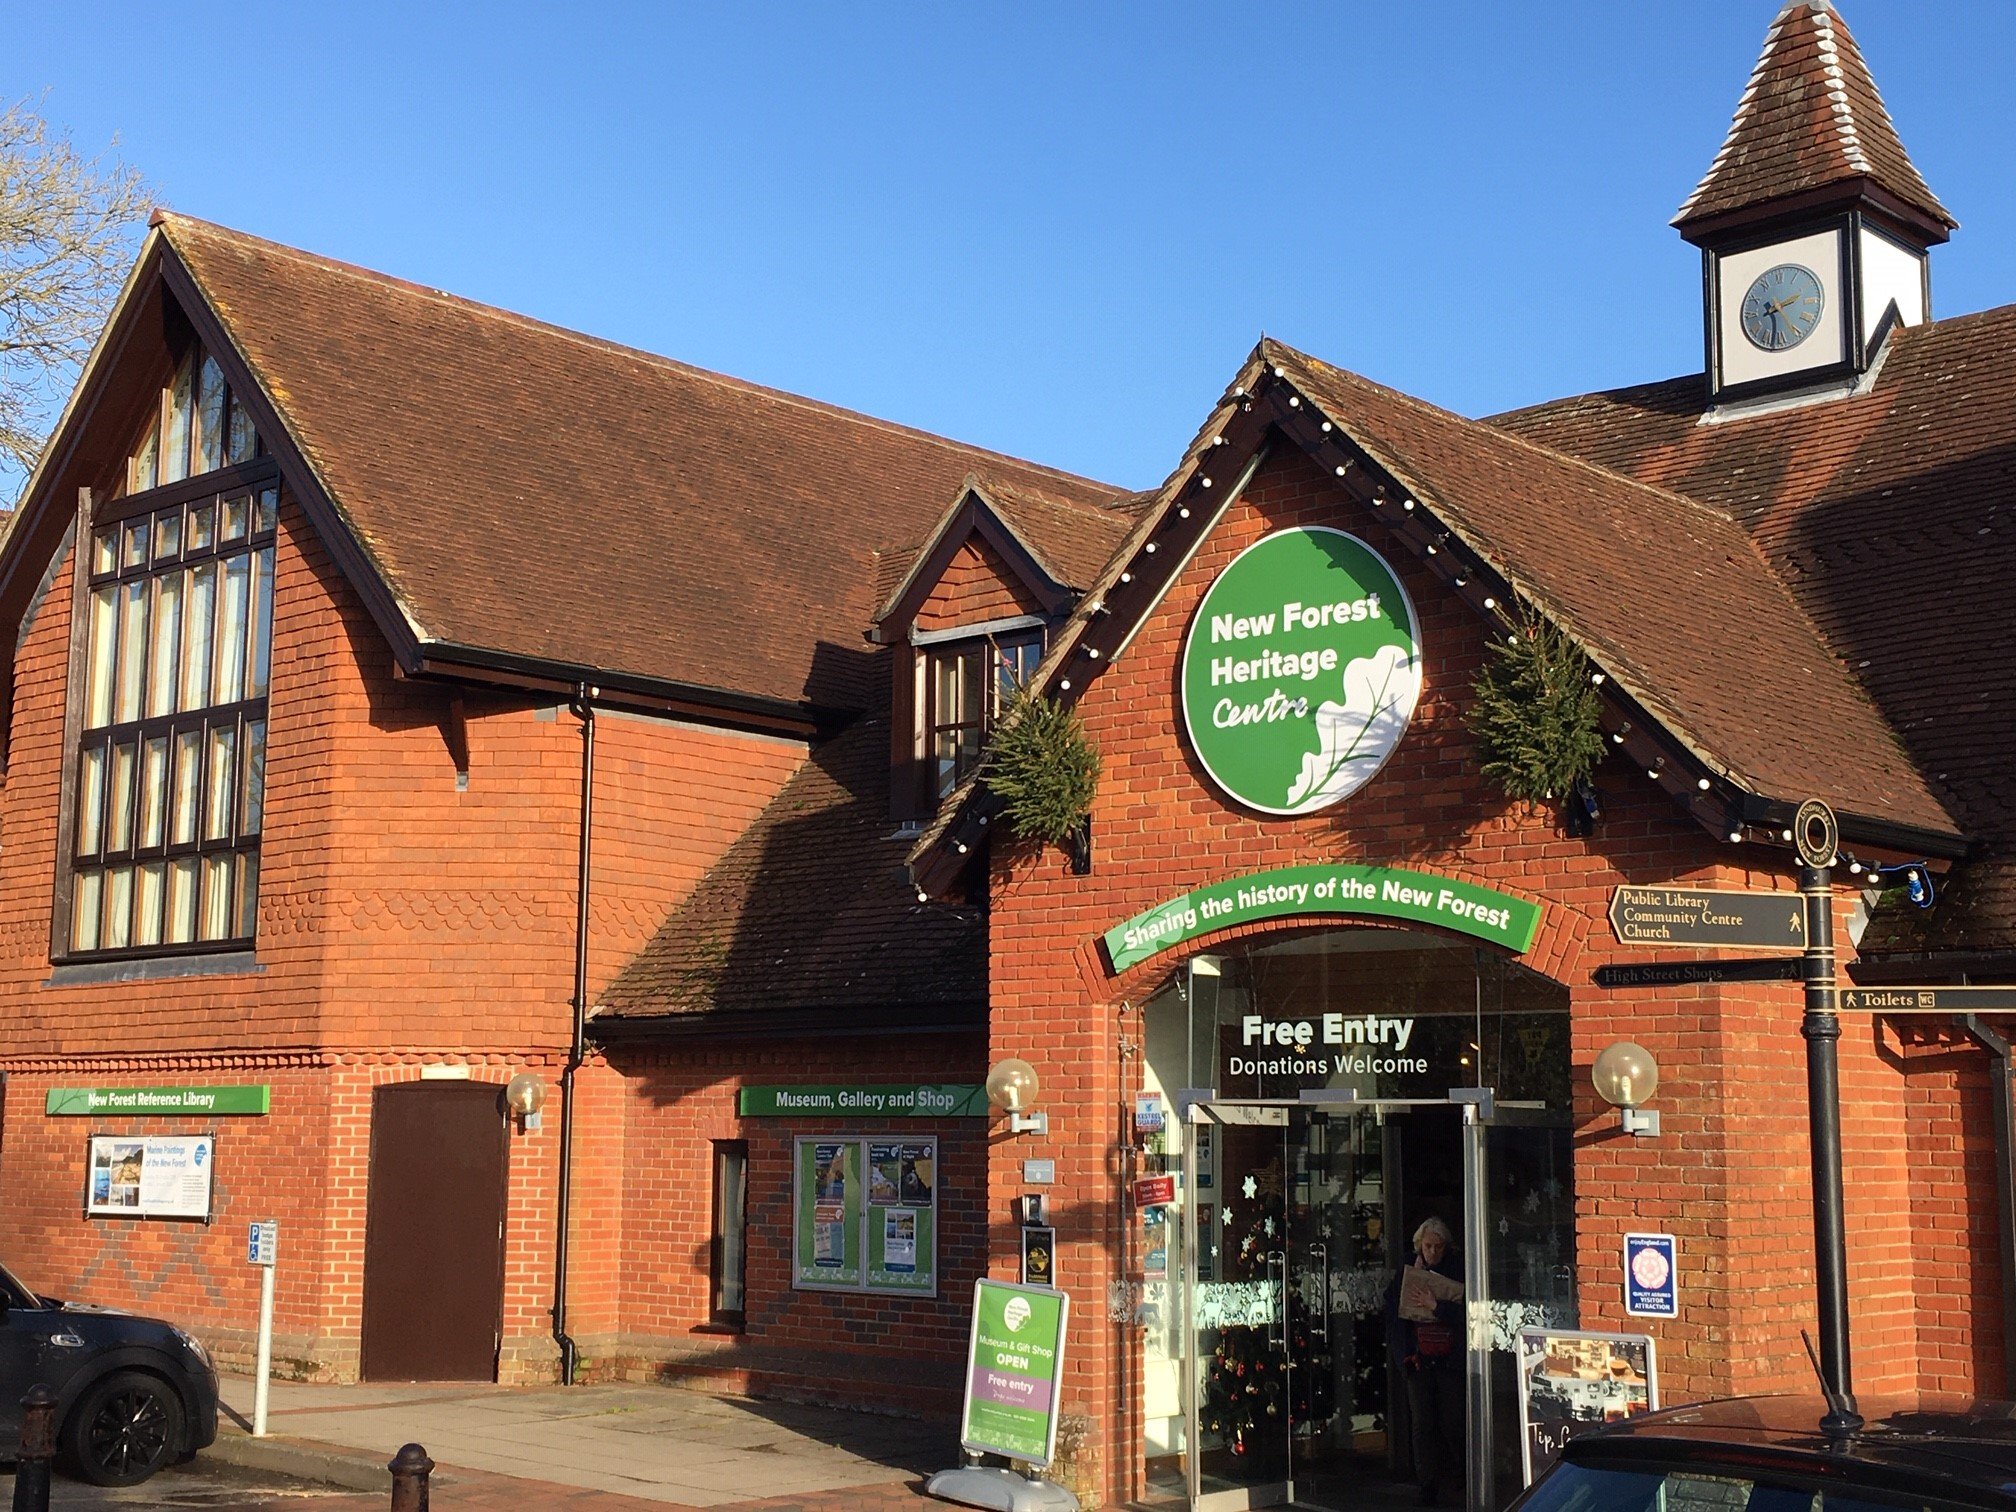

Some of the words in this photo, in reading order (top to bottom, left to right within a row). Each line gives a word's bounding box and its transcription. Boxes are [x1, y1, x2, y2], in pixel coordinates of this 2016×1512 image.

[1211, 614, 1276, 643] New
[1283, 593, 1381, 632] Forest
[1211, 649, 1338, 686] Heritage
[1212, 688, 1309, 729] Centre
[1622, 891, 1661, 906] Public
[1665, 893, 1709, 910] Library
[1123, 908, 1197, 950] Sharing
[1200, 897, 1233, 920] the
[1237, 883, 1309, 910] history
[1313, 877, 1337, 898] of
[1341, 879, 1377, 899] the
[1382, 880, 1433, 907] New
[1437, 889, 1510, 930] Forest
[1624, 908, 1697, 927] Community
[1702, 911, 1743, 926] Centre
[1624, 924, 1670, 939] Church
[1605, 969, 1638, 984] High
[1642, 967, 1680, 980] Street
[1684, 966, 1723, 980] Shops
[1861, 992, 1914, 1006] Toilets
[1920, 994, 1933, 1005] WC
[1242, 1015, 1314, 1046] Free
[1323, 1013, 1414, 1051] Entry
[1230, 1056, 1328, 1075] Donations
[1335, 1055, 1428, 1075] Welcome
[88, 1093, 107, 1106] New
[109, 1092, 136, 1106] Forest
[138, 1092, 181, 1105] Reference
[183, 1091, 215, 1109] Library
[776, 1091, 835, 1109] Museum,
[838, 1091, 885, 1110] Gallery
[889, 1091, 914, 1107] and
[917, 1091, 954, 1110] Shop
[979, 1335, 1008, 1349] Museum
[1009, 1341, 1015, 1350] &
[1017, 1342, 1031, 1353] Gift
[1032, 1345, 1053, 1359] Shop
[996, 1353, 1029, 1370] OPEN
[988, 1374, 1008, 1388] Free
[1009, 1380, 1034, 1395] entry
